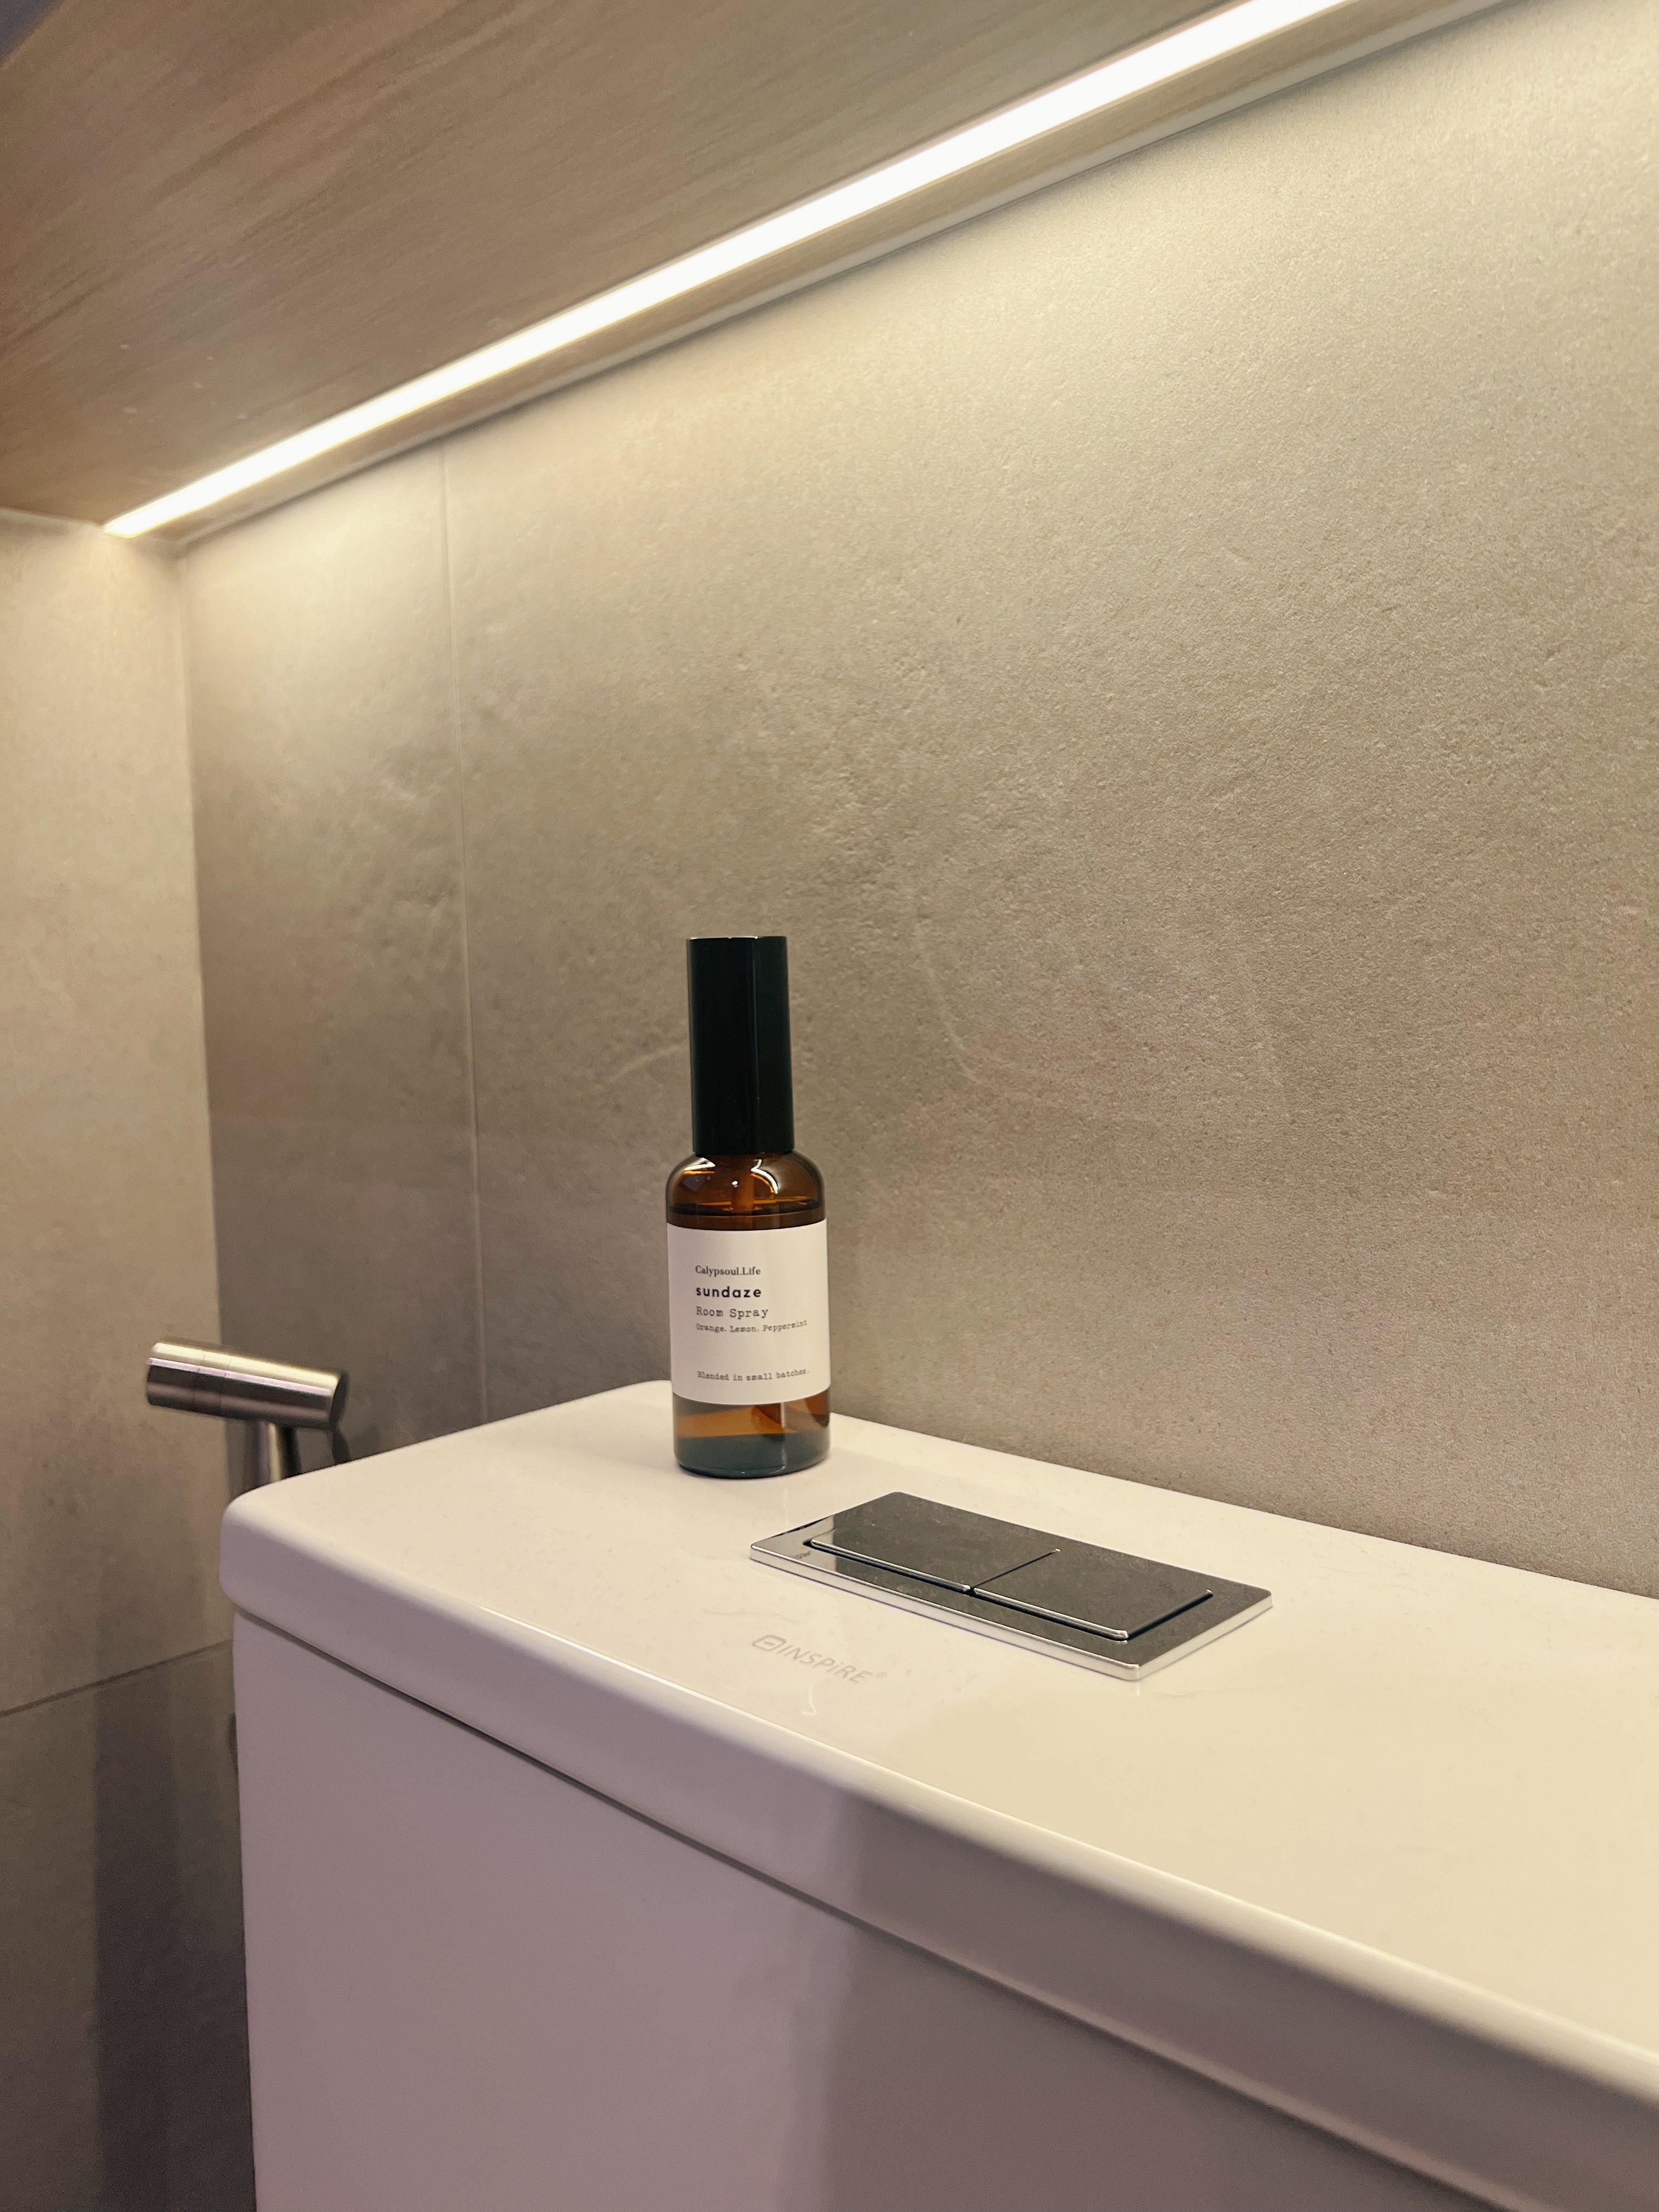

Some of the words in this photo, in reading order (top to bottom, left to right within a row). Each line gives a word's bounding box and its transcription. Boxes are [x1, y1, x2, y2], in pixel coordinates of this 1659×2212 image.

[695, 1265, 761, 1277] Calypsoul.Life
[696, 1285, 761, 1298] sundaze
[696, 1306, 724, 1317] Room
[730, 1308, 769, 1319] Spray
[763, 1320, 807, 1332] Peppermint
[697, 1370, 729, 1381] Blended
